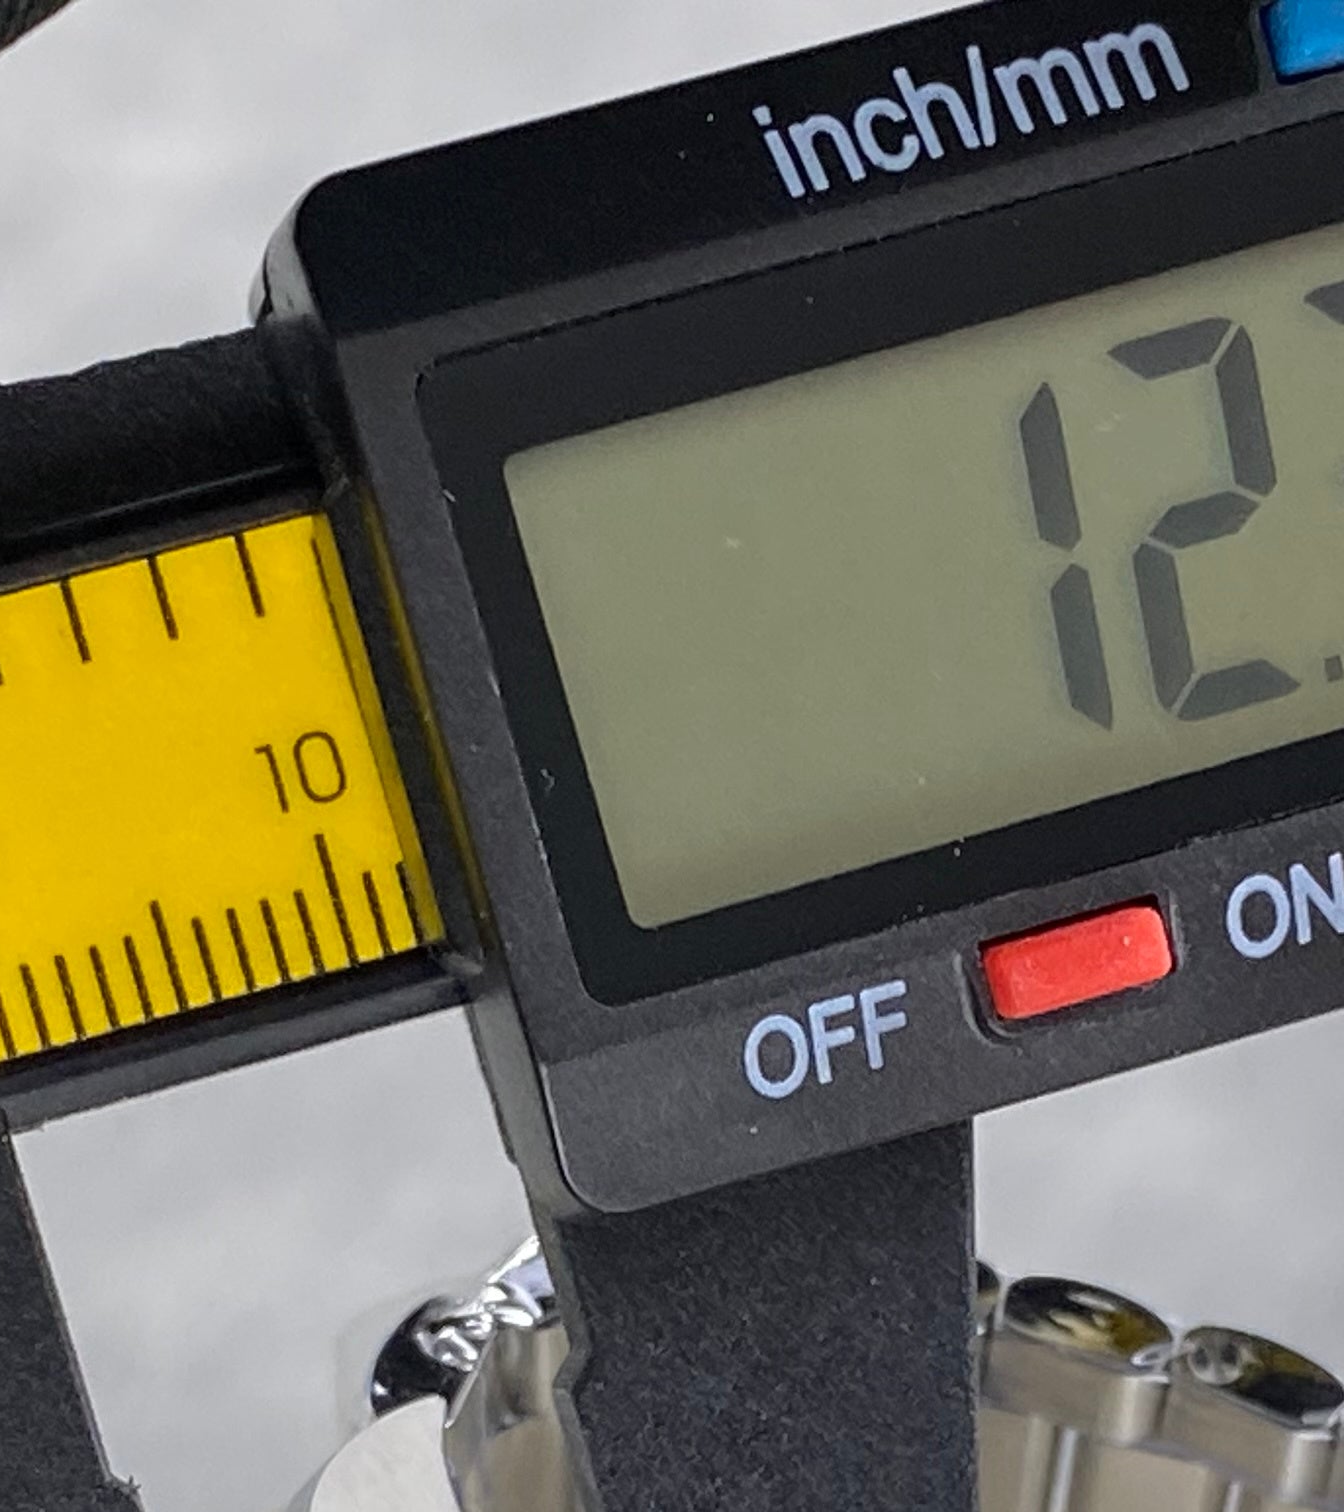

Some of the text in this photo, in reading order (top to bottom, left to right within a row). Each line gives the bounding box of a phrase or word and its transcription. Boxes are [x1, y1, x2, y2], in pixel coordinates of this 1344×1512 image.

[752, 20, 1191, 198] inch/mm
[253, 730, 347, 813] 10
[743, 979, 907, 1100] OFF
